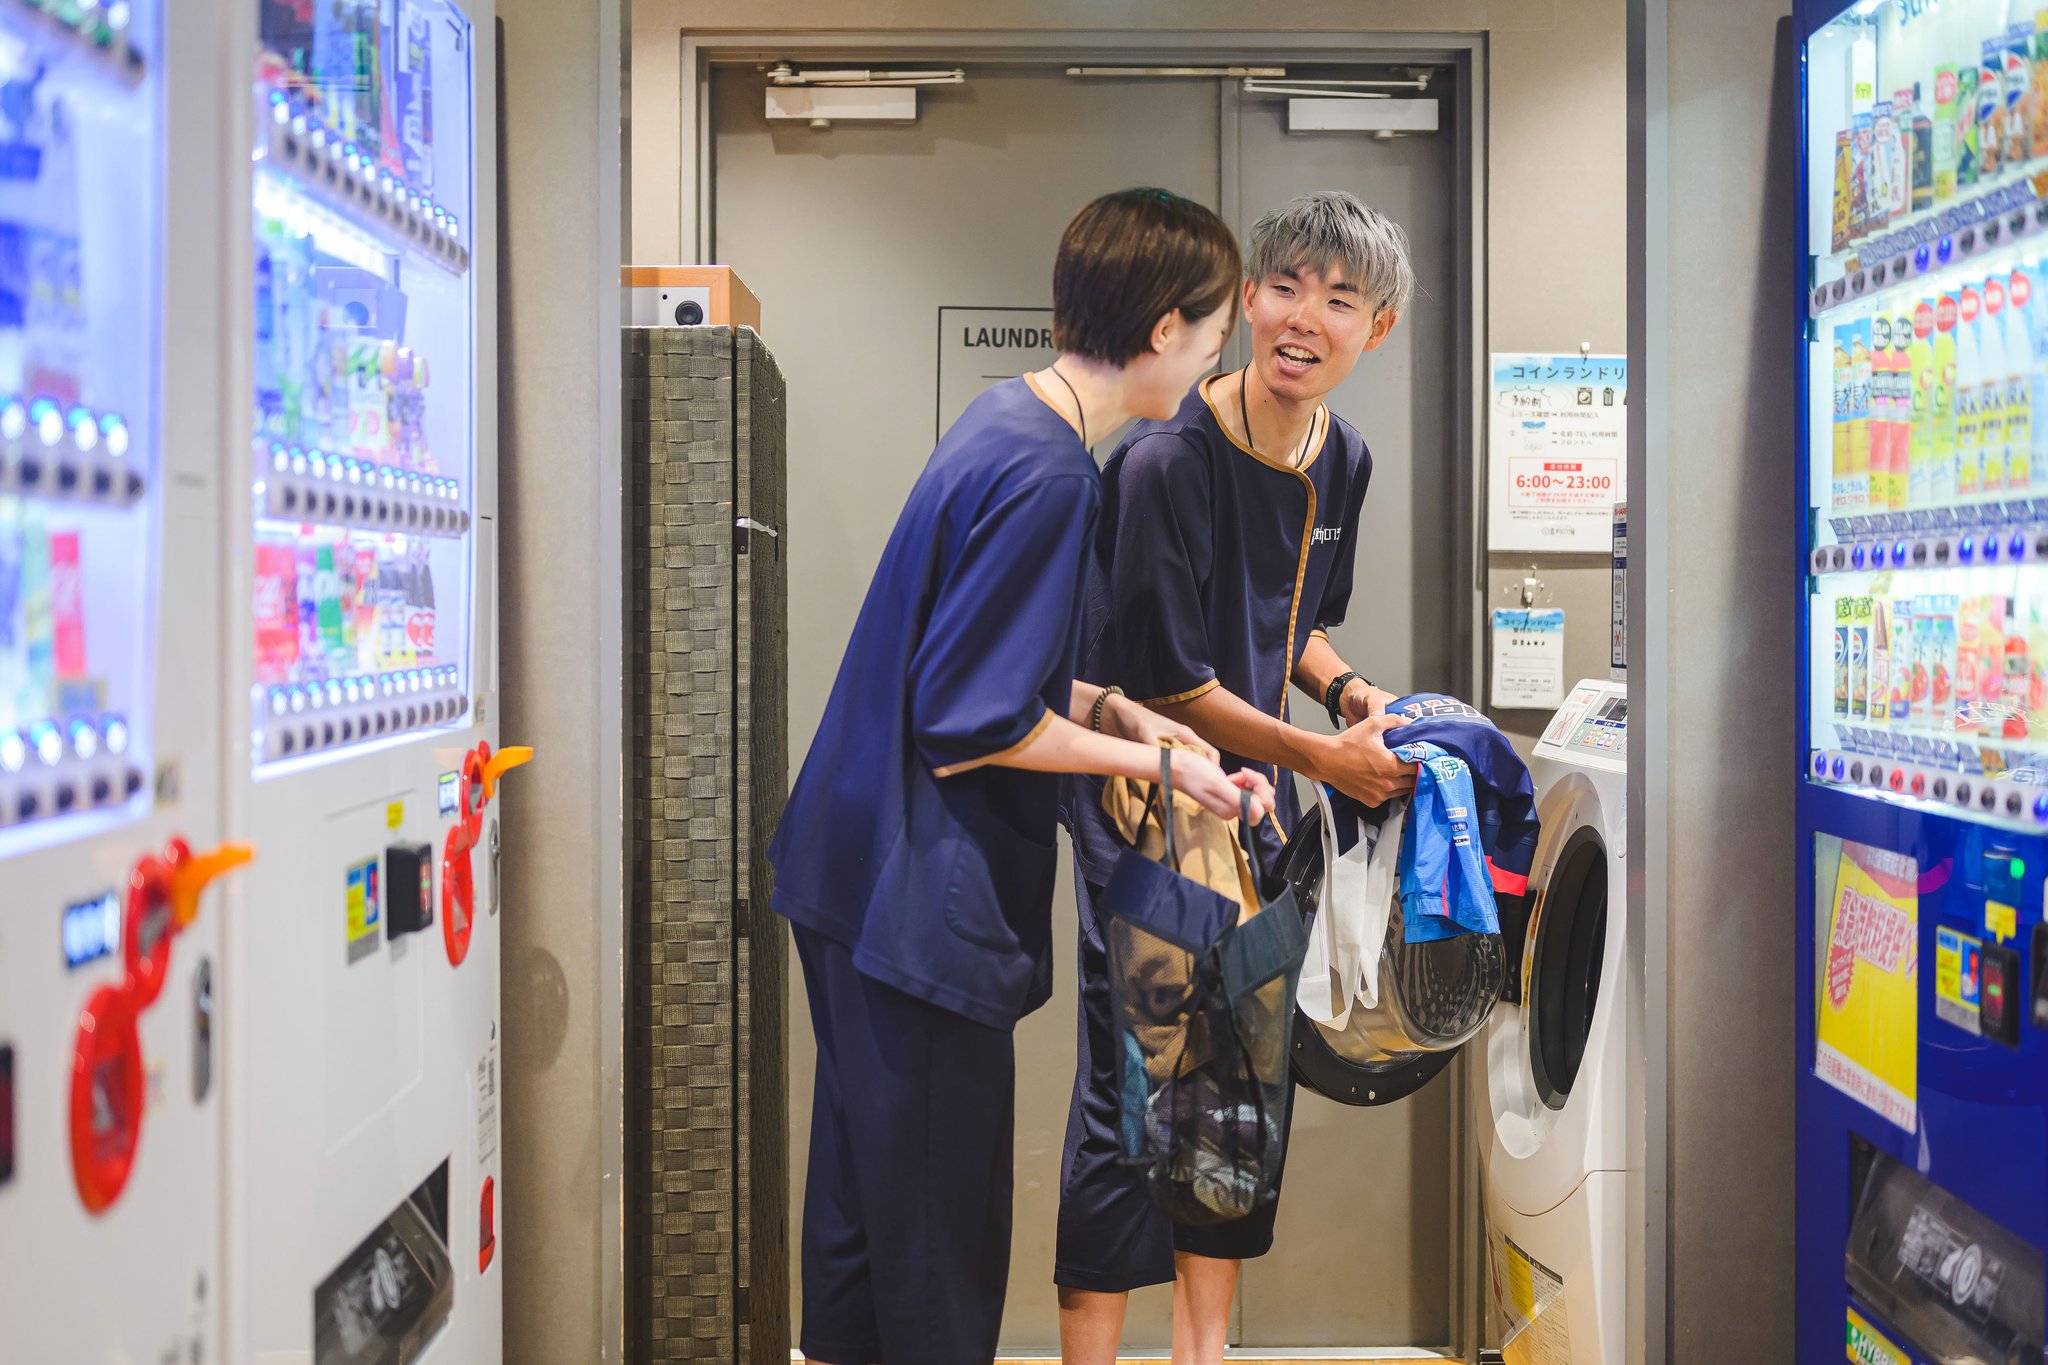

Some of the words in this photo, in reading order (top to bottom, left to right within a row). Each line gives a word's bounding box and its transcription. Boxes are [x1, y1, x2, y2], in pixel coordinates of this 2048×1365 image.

[964, 327, 1053, 349] LAUNDR
[1513, 366, 1624, 380] コインランドリ
